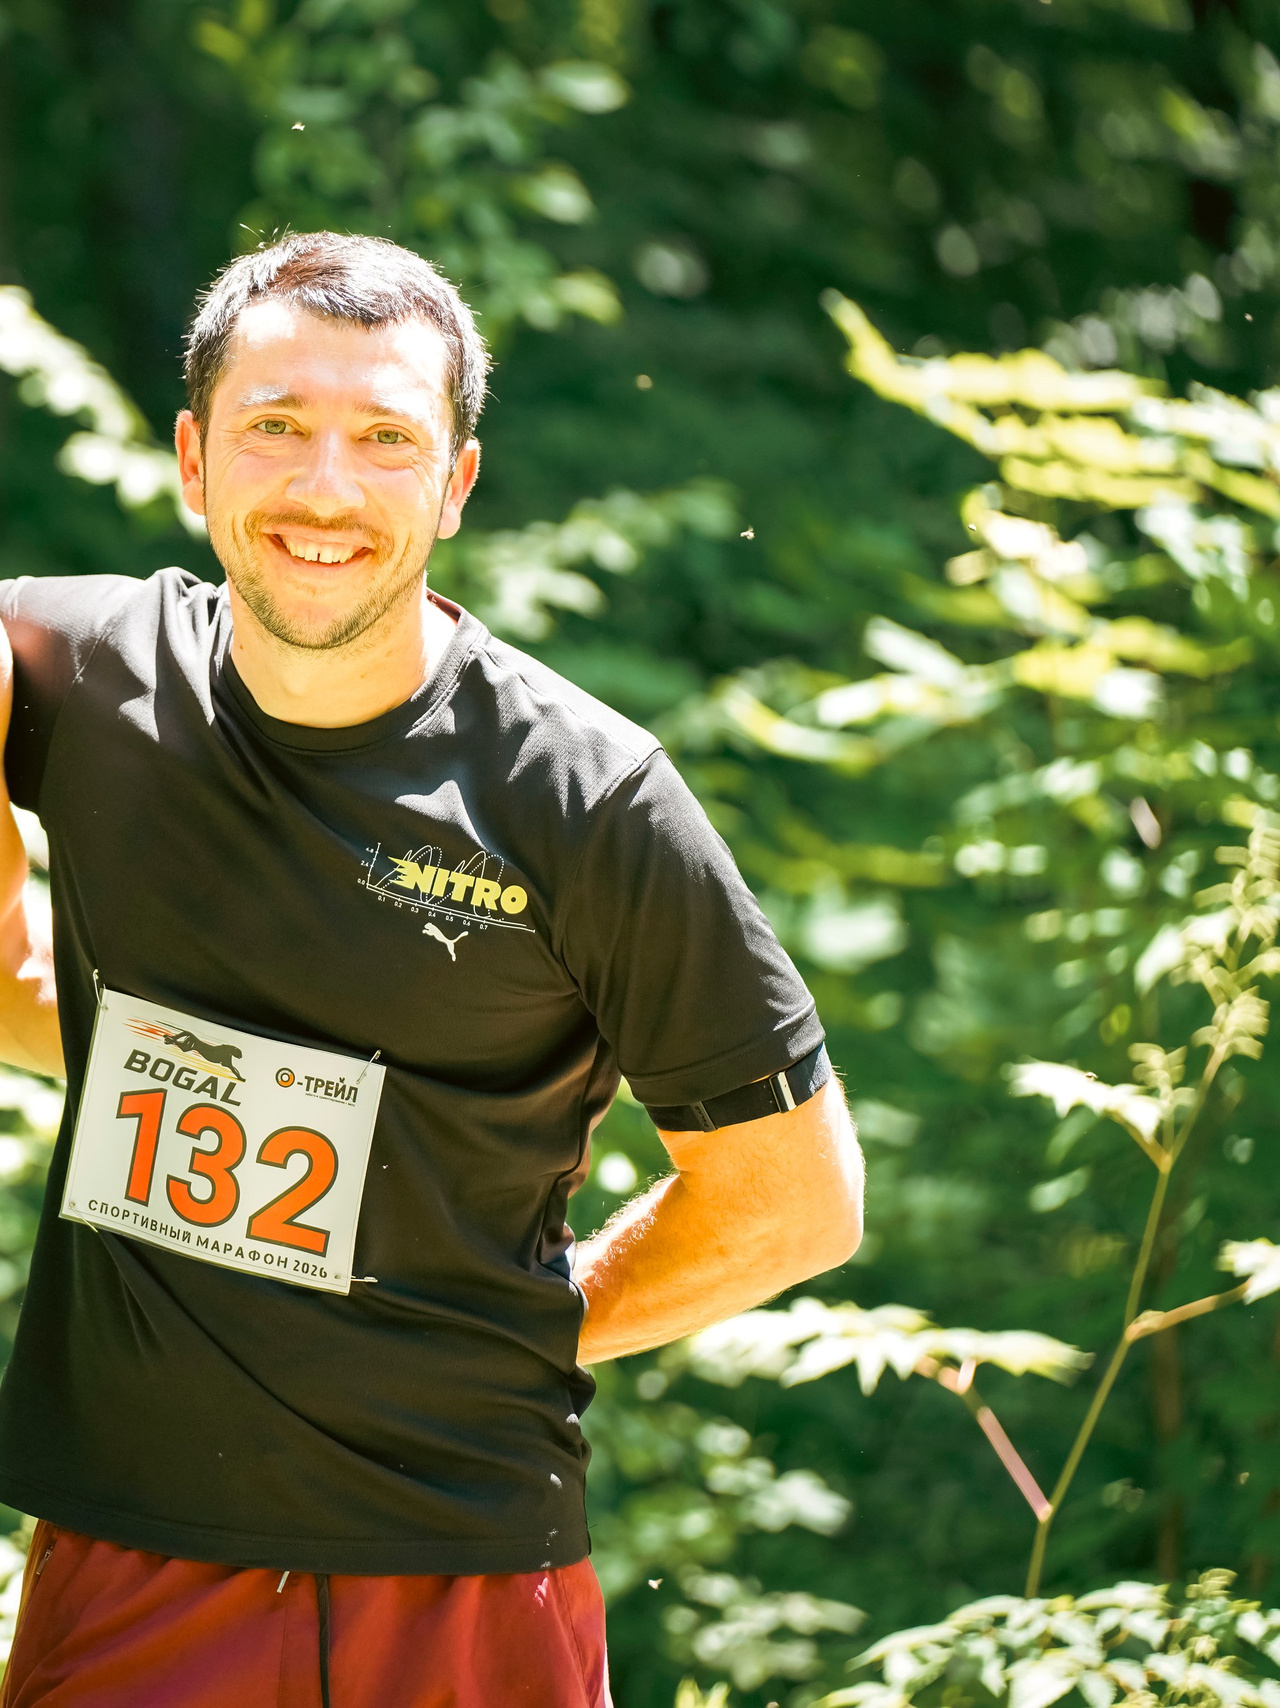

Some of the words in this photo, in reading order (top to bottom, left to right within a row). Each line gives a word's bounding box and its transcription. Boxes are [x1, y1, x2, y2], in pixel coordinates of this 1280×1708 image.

[357, 877, 366, 886] 0.0
[360, 859, 370, 868] 2.4
[387, 856, 528, 915] NITRO
[410, 906, 419, 914] 0.3
[479, 923, 489, 931] 0.7
[123, 1048, 242, 1107] BOGAL
[116, 1087, 339, 1259] 132
[88, 1199, 191, 1244] СПОРТИВНЫЙ
[195, 1234, 289, 1269] МАРАФОН
[292, 1258, 328, 1279] 2026
